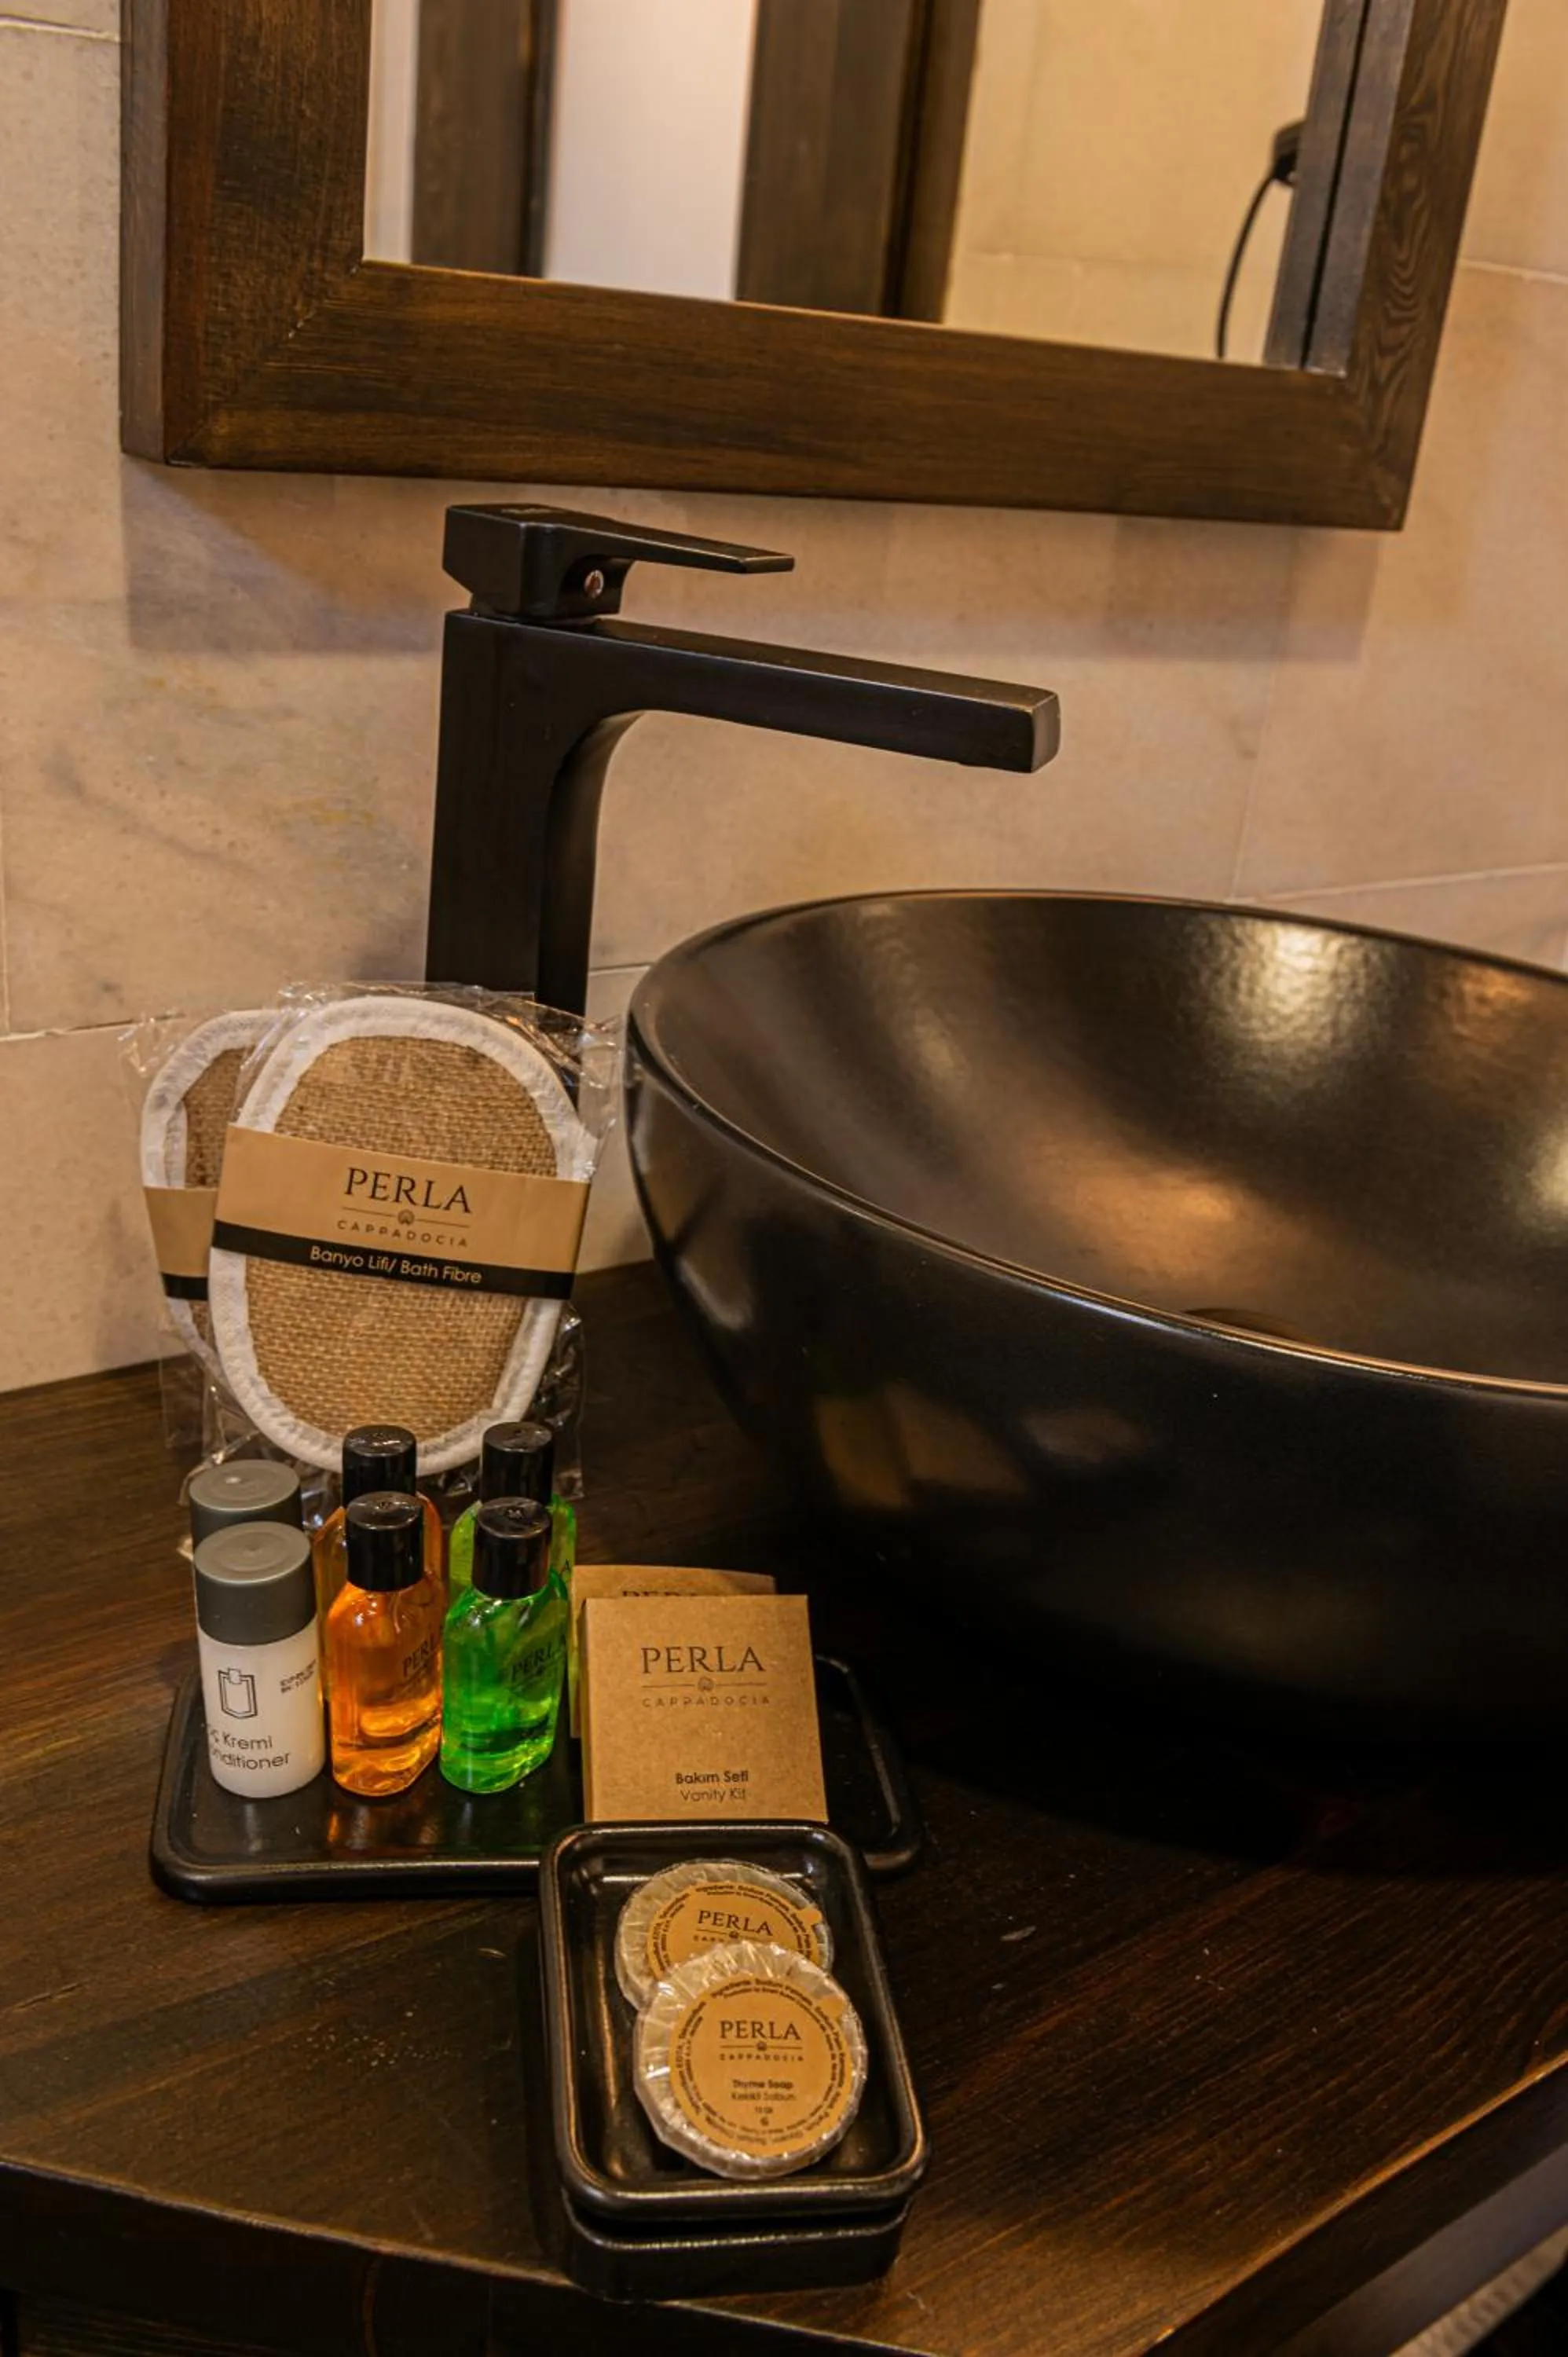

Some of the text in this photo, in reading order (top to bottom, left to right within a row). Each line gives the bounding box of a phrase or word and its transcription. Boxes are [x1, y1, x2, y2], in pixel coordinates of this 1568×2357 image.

[344, 1167, 471, 1213] PERLA
[337, 1219, 467, 1248] CAPPADOCIA
[310, 1245, 365, 1268] Banyo
[400, 1259, 438, 1278] Bath
[442, 1266, 482, 1284] Fibre
[641, 1646, 767, 1673] PERLA
[642, 1695, 771, 1708] CAPPADOCIA
[222, 1731, 273, 1750] Kremi
[724, 1770, 749, 1783] Seti
[680, 1789, 726, 1803] Vanity
[698, 1910, 773, 1937] PERLA
[720, 2020, 801, 2040] PERLA
